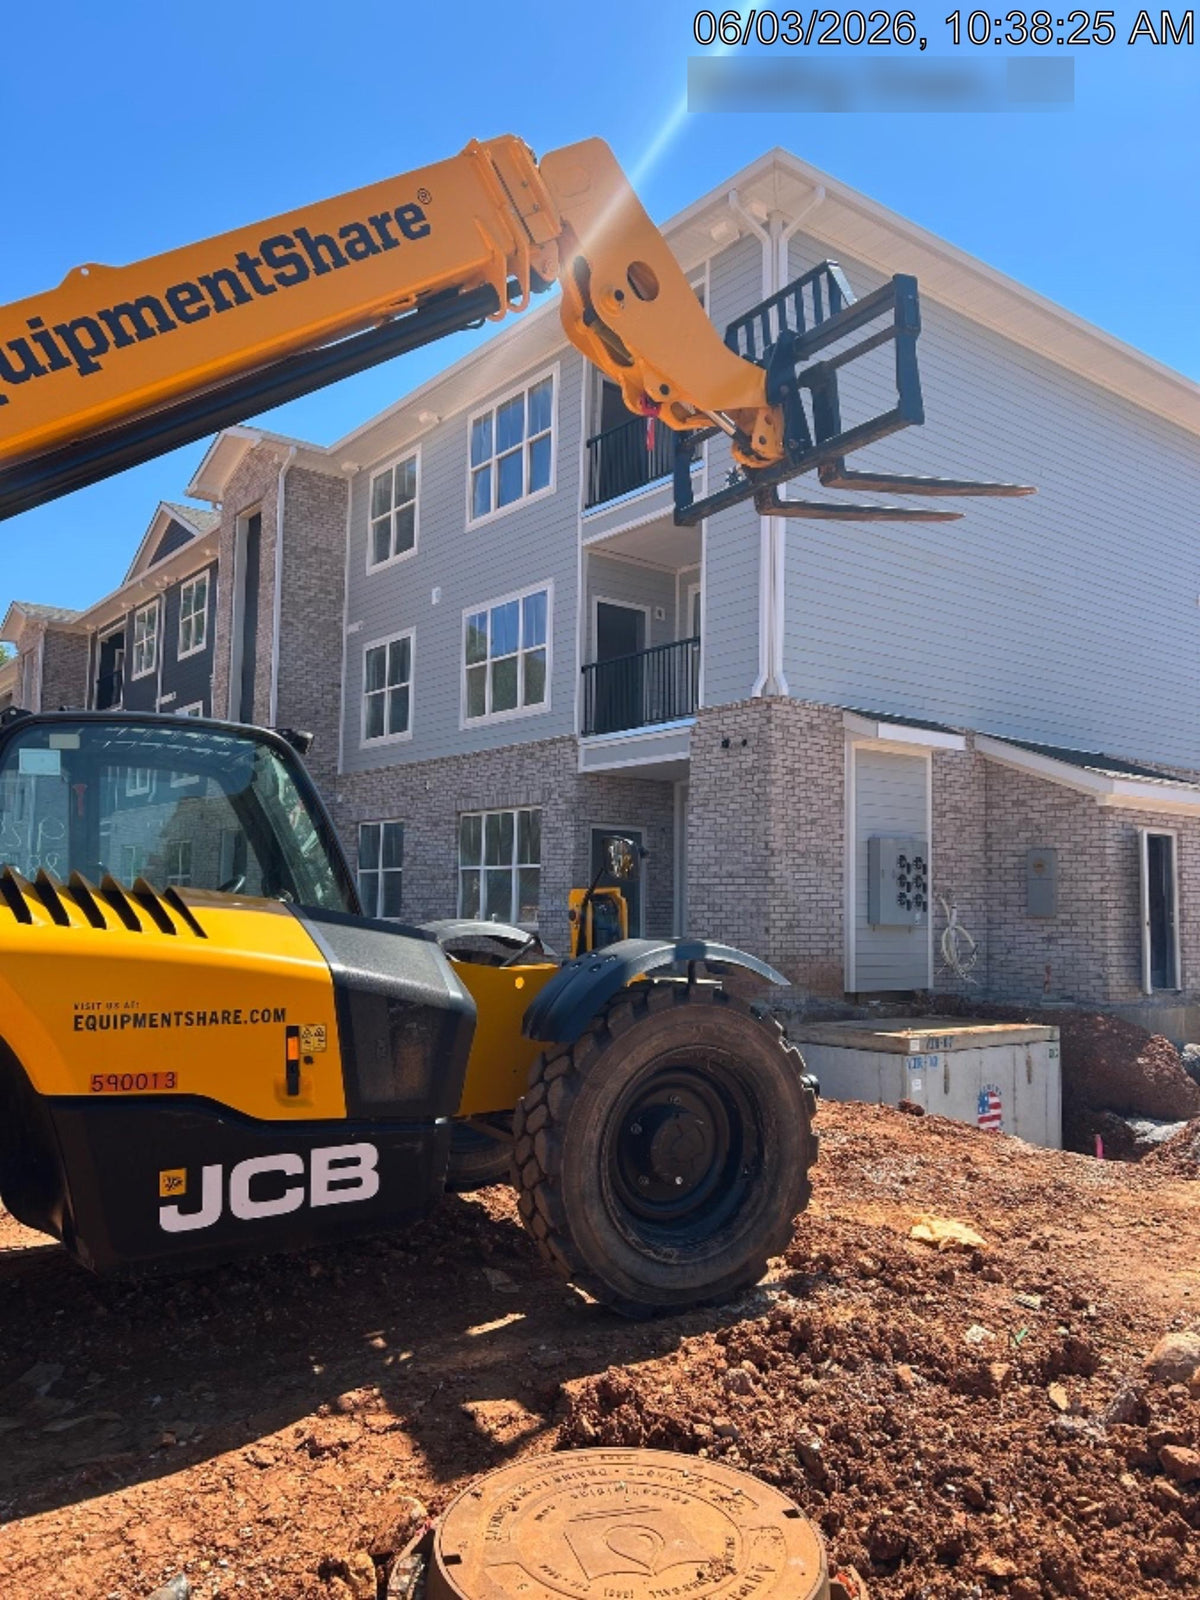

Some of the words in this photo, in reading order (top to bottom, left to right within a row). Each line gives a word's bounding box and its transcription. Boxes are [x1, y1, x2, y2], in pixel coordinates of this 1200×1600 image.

[73, 1001, 103, 1011] VISIT
[73, 1007, 288, 1032] EQUIPMENTSHARE.COM
[91, 1072, 177, 1093] 590013
[158, 1142, 381, 1233] JCB
